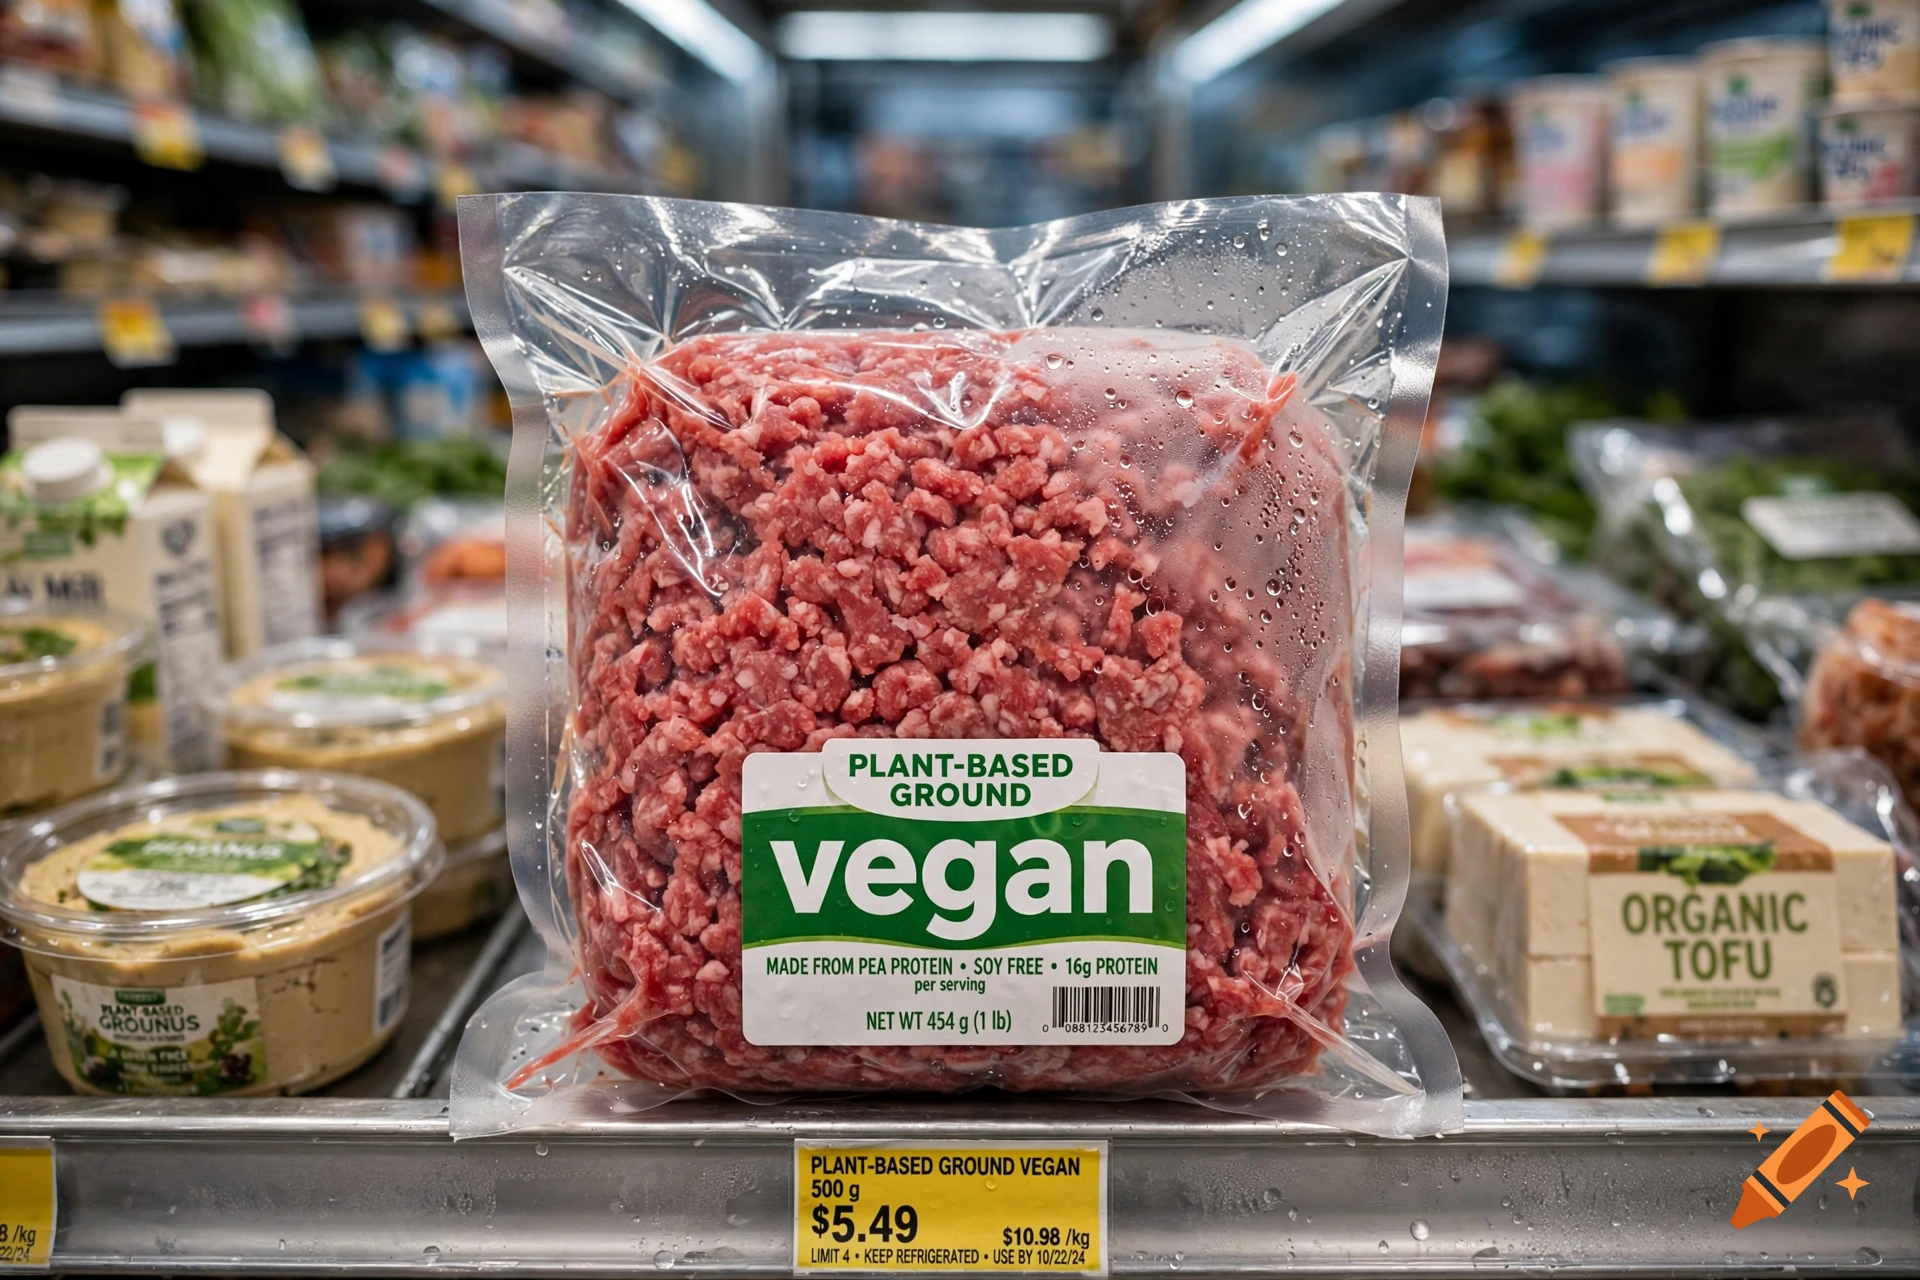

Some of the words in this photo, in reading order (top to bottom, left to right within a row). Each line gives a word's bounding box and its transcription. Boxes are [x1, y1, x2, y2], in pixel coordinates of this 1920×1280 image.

[849, 753, 1074, 778] PLANT-BASED
[890, 782, 1032, 807] GROUND
[769, 838, 1154, 942] vegan
[1621, 892, 1808, 935] ORGANIC
[766, 956, 809, 975] MADE
[813, 957, 854, 976] FROM
[858, 957, 887, 975] PEA
[891, 957, 953, 976] PROTEIN
[973, 957, 1003, 976] SOY
[1007, 957, 1044, 975] FREE
[1065, 957, 1092, 979] 16g
[1096, 957, 1158, 976] PROTEIN
[1663, 939, 1772, 981] TOFU
[914, 980, 937, 995] per
[940, 977, 986, 995] serving
[98, 1014, 201, 1033] GROUNUS
[866, 1011, 895, 1031] NET
[898, 1011, 924, 1030] WT
[926, 1011, 955, 1031] 454
[959, 1016, 969, 1035] g
[973, 1010, 986, 1035] (1
[992, 1009, 1012, 1033] lb)
[1064, 1023, 1148, 1034] 088123456789
[811, 1155, 934, 1175] PLANT-BASED
[938, 1156, 1015, 1176] GROUND
[1019, 1156, 1080, 1176] VEGAN
[811, 1178, 844, 1199] 500
[848, 1183, 860, 1203] g
[12, 1224, 37, 1247] /kg
[811, 1203, 918, 1244] $5.49
[1002, 1226, 1061, 1247] $10.98
[1065, 1227, 1090, 1250] /kg
[811, 1247, 840, 1264] LIMIT
[842, 1249, 850, 1263] 4
[864, 1248, 894, 1264] KEEP
[896, 1248, 980, 1265] REFRIGERATED
[993, 1248, 1015, 1265] USE
[1018, 1249, 1034, 1265] BY
[1036, 1248, 1086, 1266] 10/22/24
